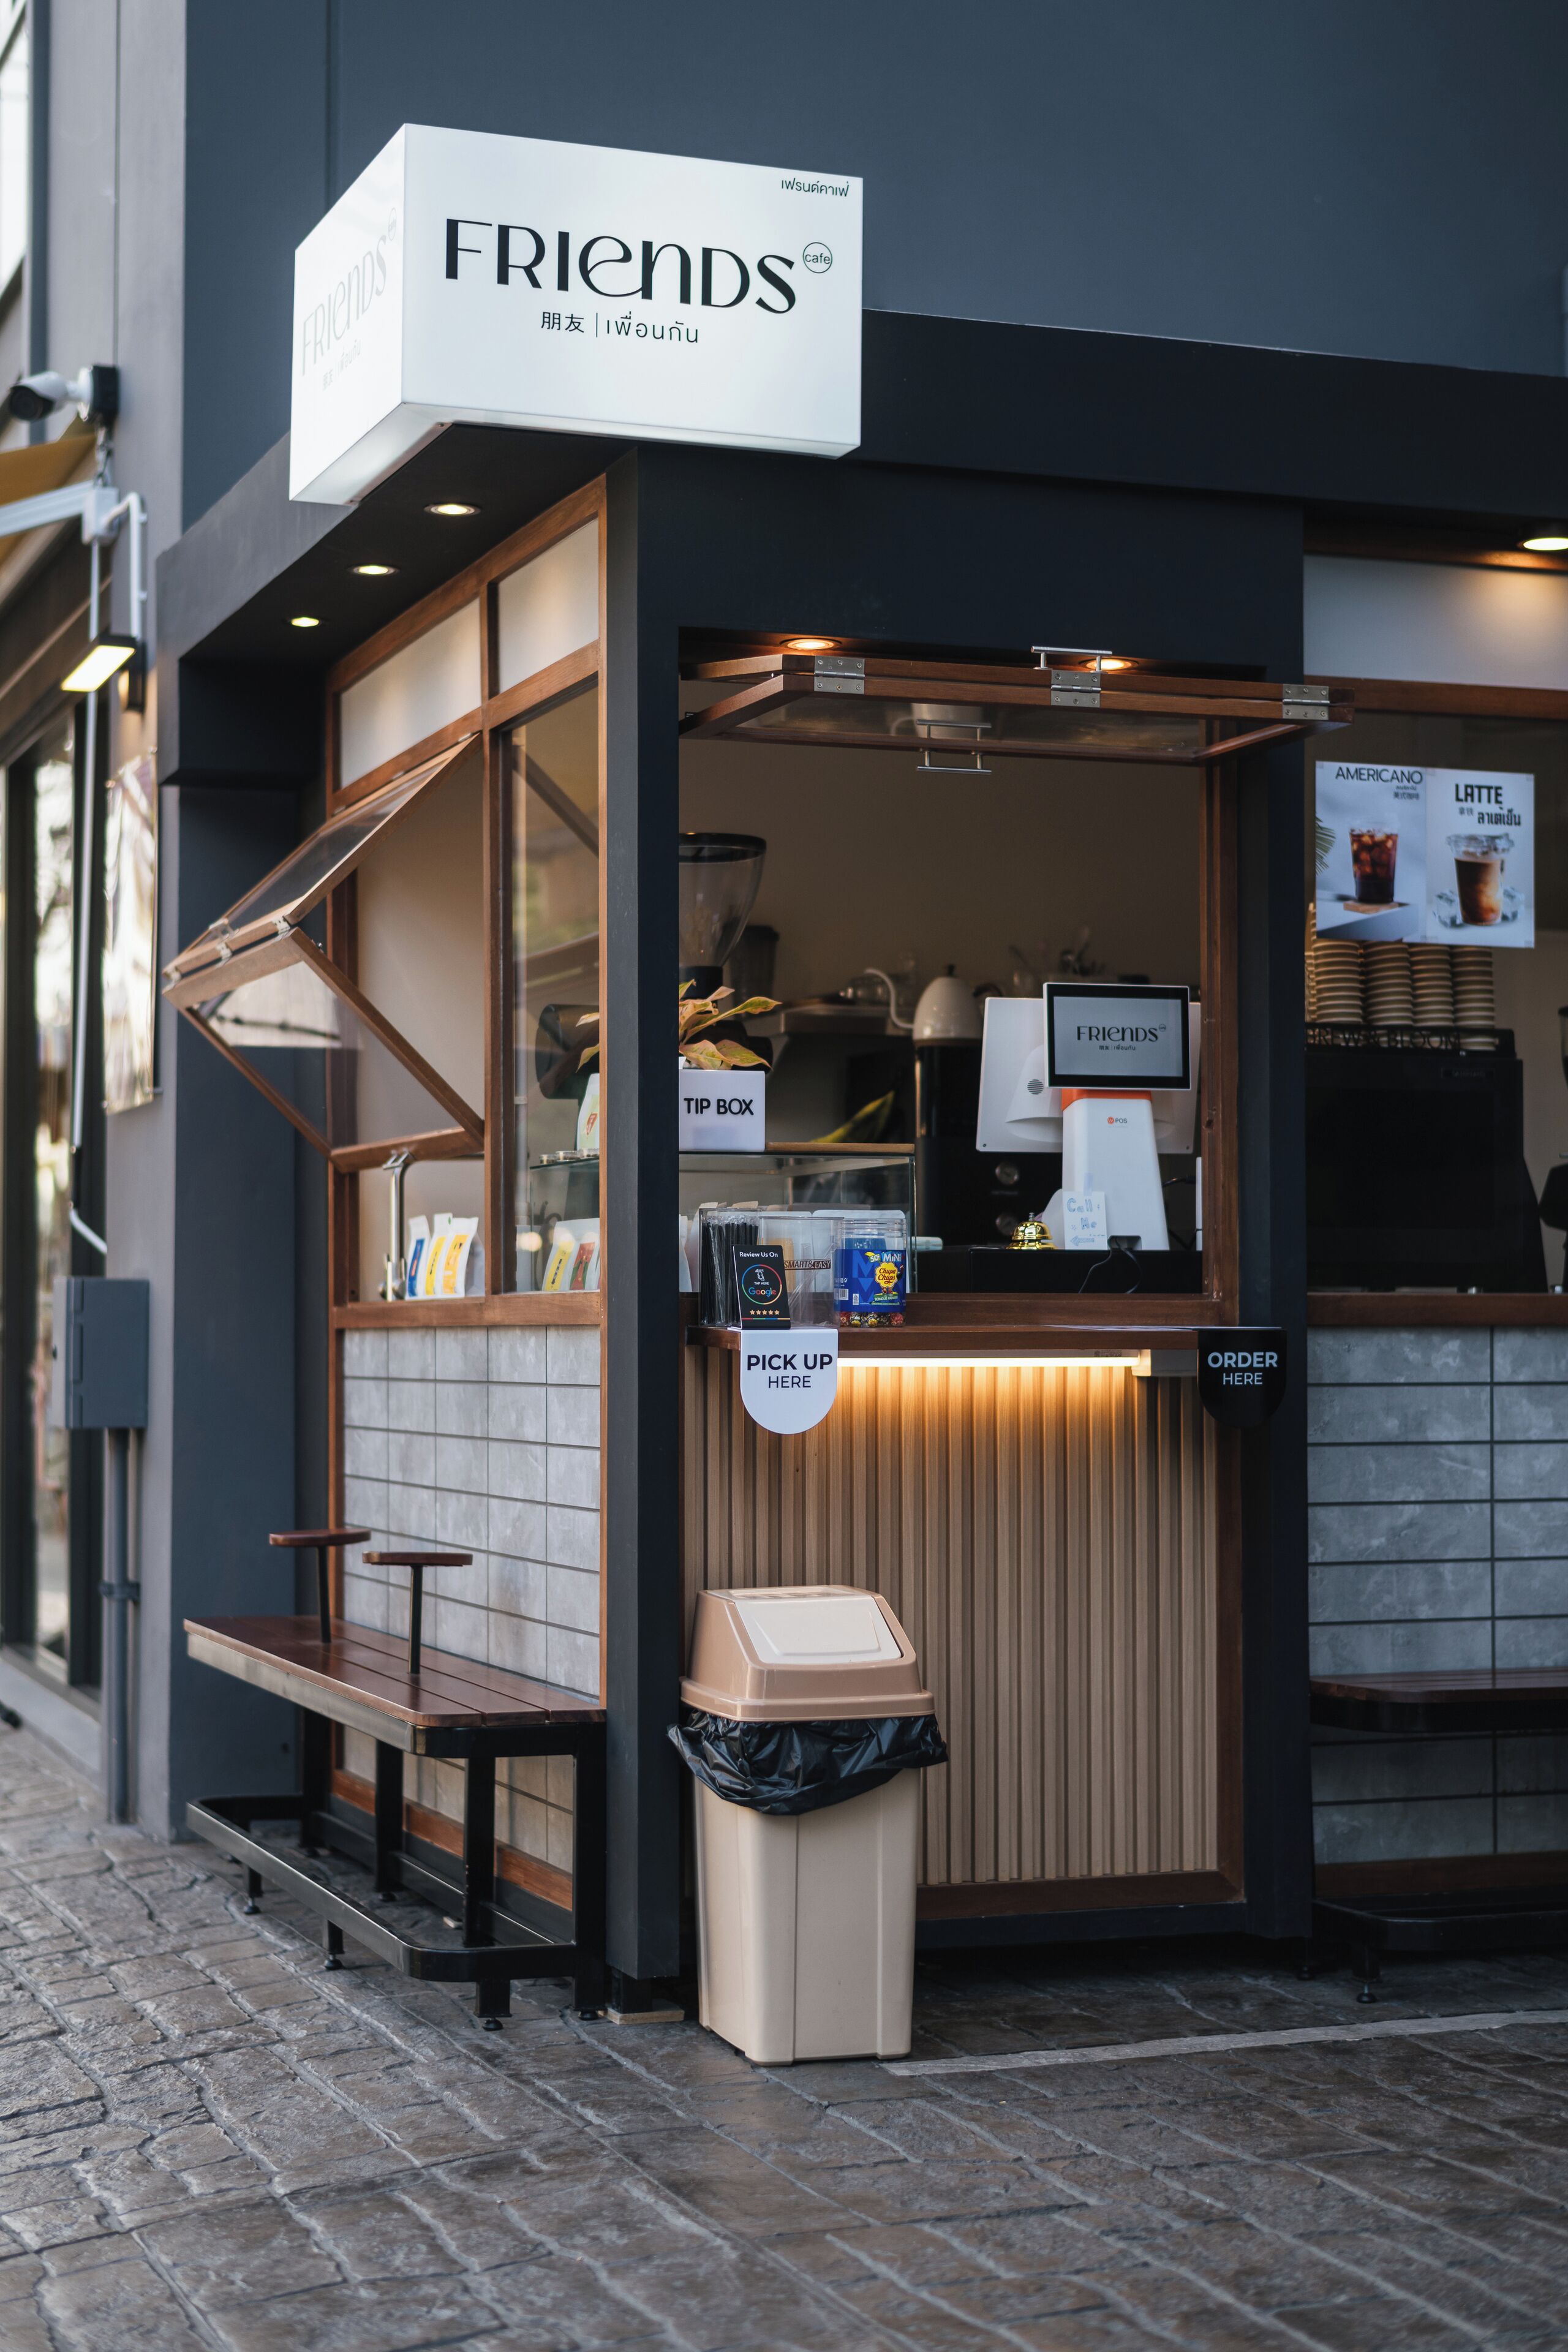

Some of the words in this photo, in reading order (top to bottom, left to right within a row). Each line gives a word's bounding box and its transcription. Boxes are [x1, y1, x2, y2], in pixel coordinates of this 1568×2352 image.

[781, 178, 850, 197] เฟรนด์คาเฟ่
[805, 252, 831, 265] cafe
[541, 311, 584, 333] 朋友
[606, 311, 698, 343] เพื่อนกัน
[1335, 766, 1423, 785] AMERICANO
[1455, 783, 1503, 804] LATTE
[684, 1098, 711, 1115] TIP
[717, 1098, 754, 1115] BOX
[878, 1273, 895, 1284] Chups
[748, 1287, 776, 1297] Google
[747, 1354, 797, 1371] PICK
[804, 1354, 833, 1370] UP
[1207, 1352, 1278, 1368] ORDER
[768, 1376, 812, 1388] HERE
[1223, 1372, 1263, 1385] HERE
